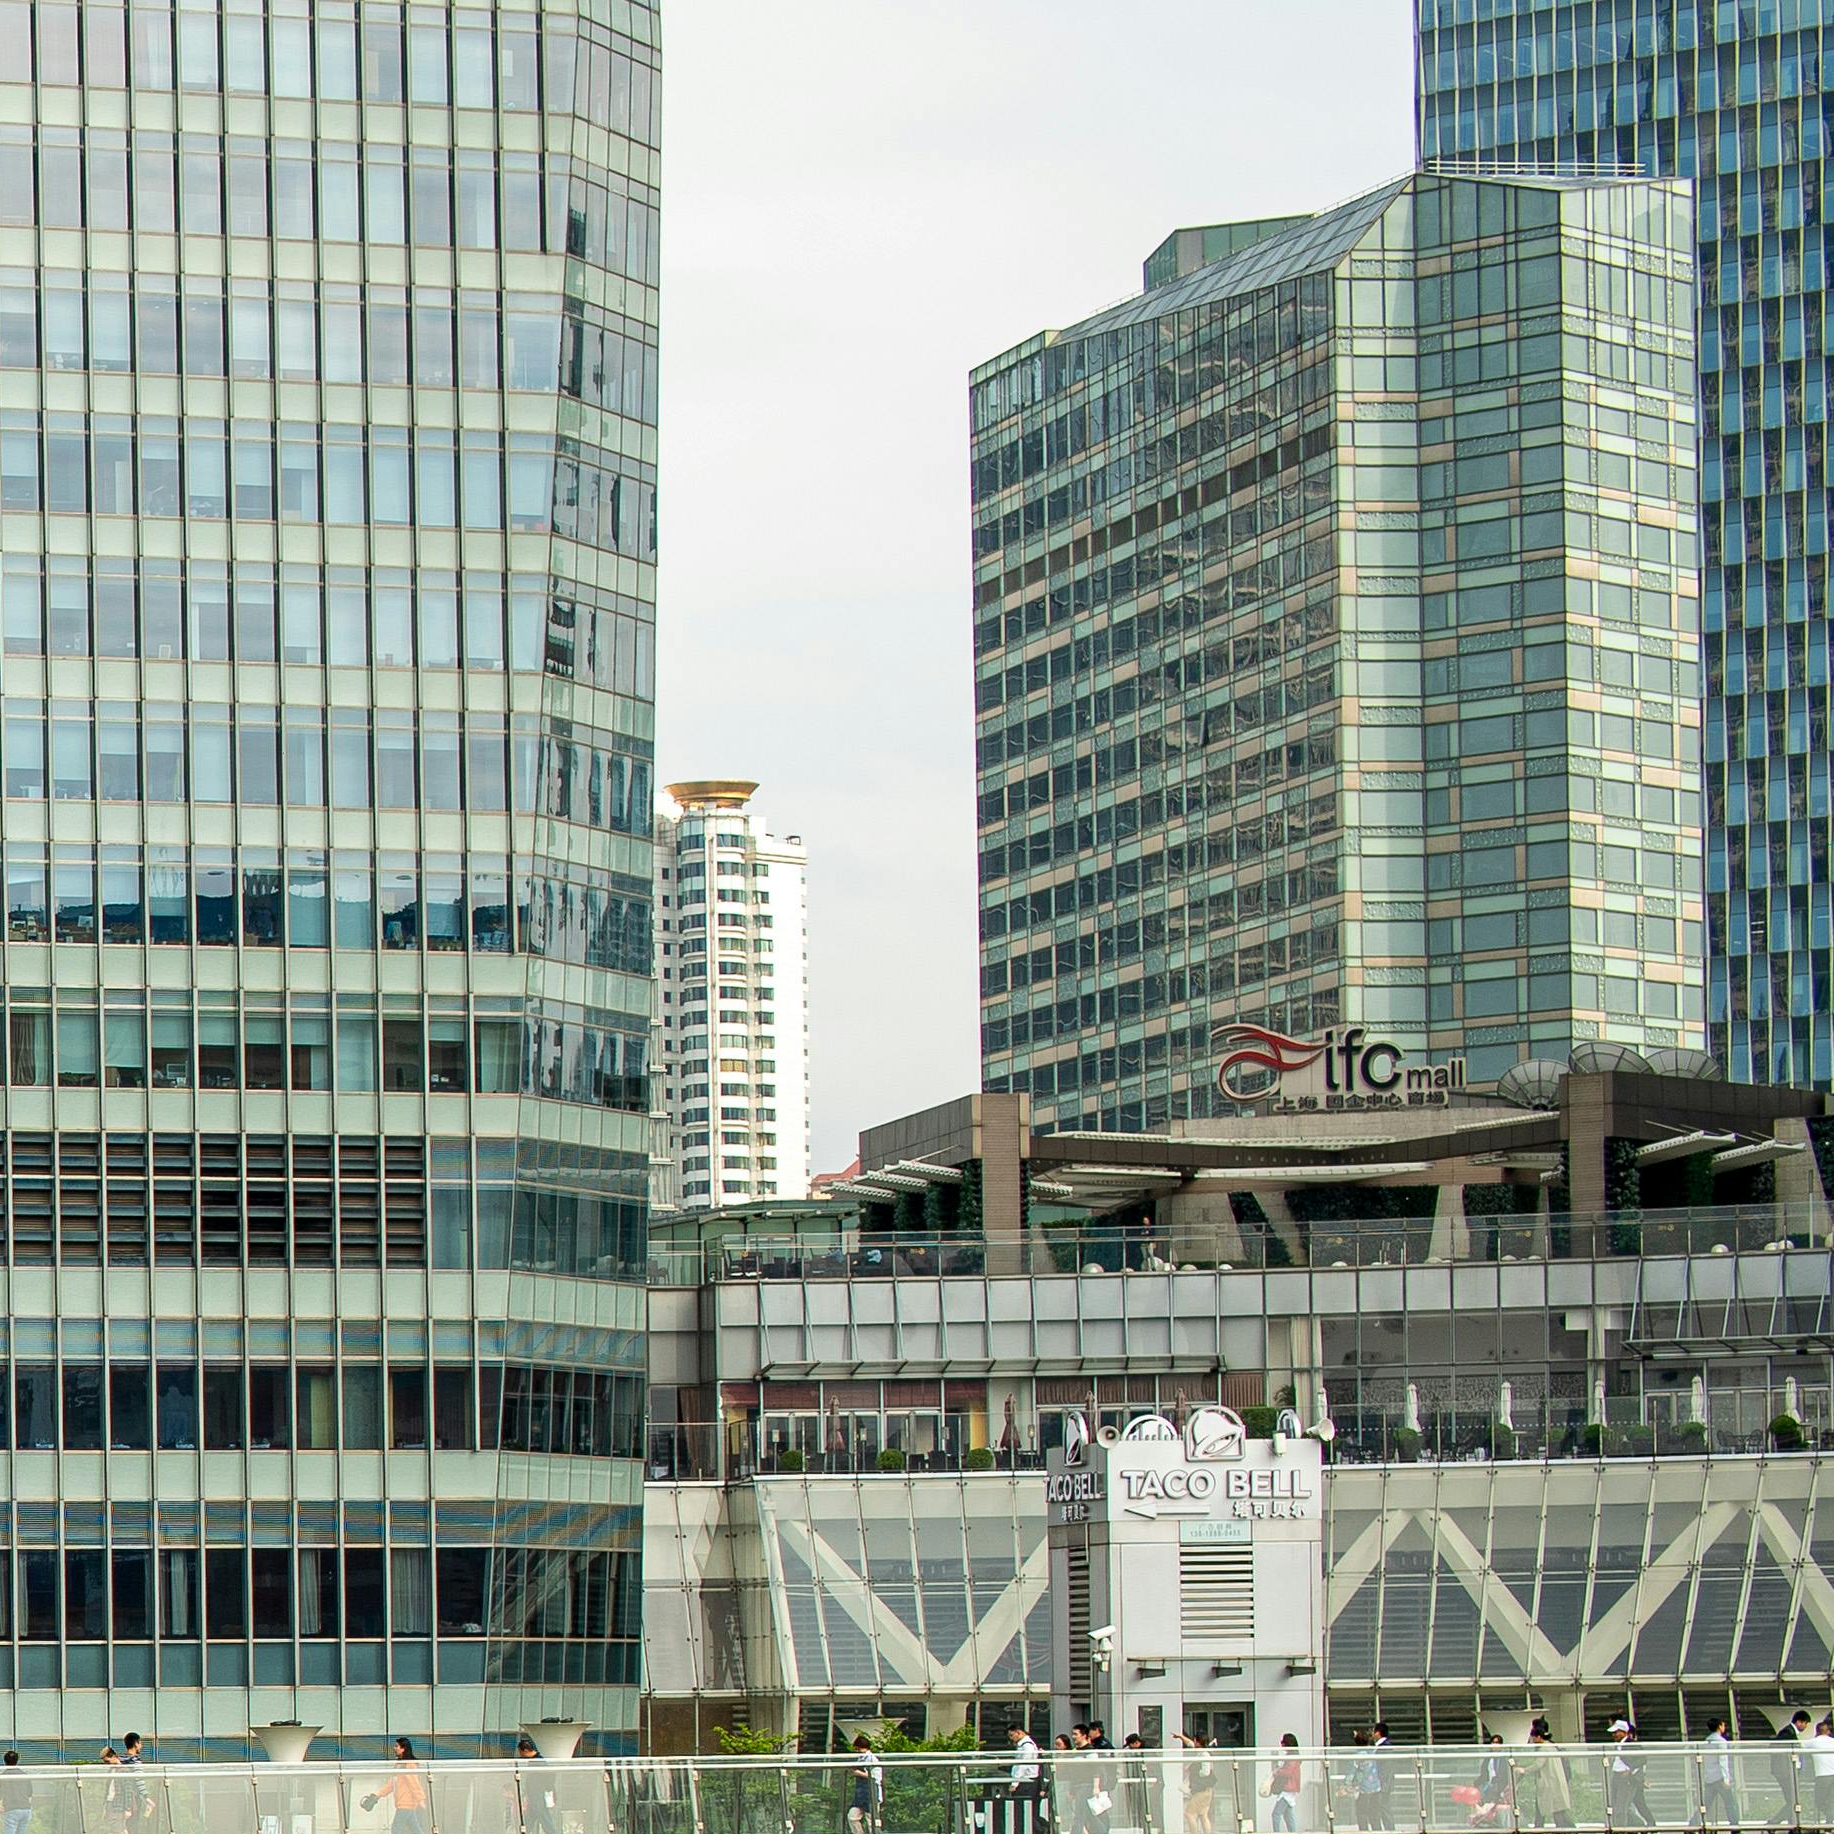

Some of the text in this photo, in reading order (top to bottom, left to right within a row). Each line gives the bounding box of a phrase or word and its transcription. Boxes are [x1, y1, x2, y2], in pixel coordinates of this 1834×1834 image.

[1406, 1057, 1465, 1089] mall
[1275, 1096, 1318, 1111] 上海
[1044, 1472, 1103, 1503] TACO BELL
[1121, 1469, 1312, 1499] TACO BELL
[1233, 1500, 1306, 1519] 塔可贝尔
